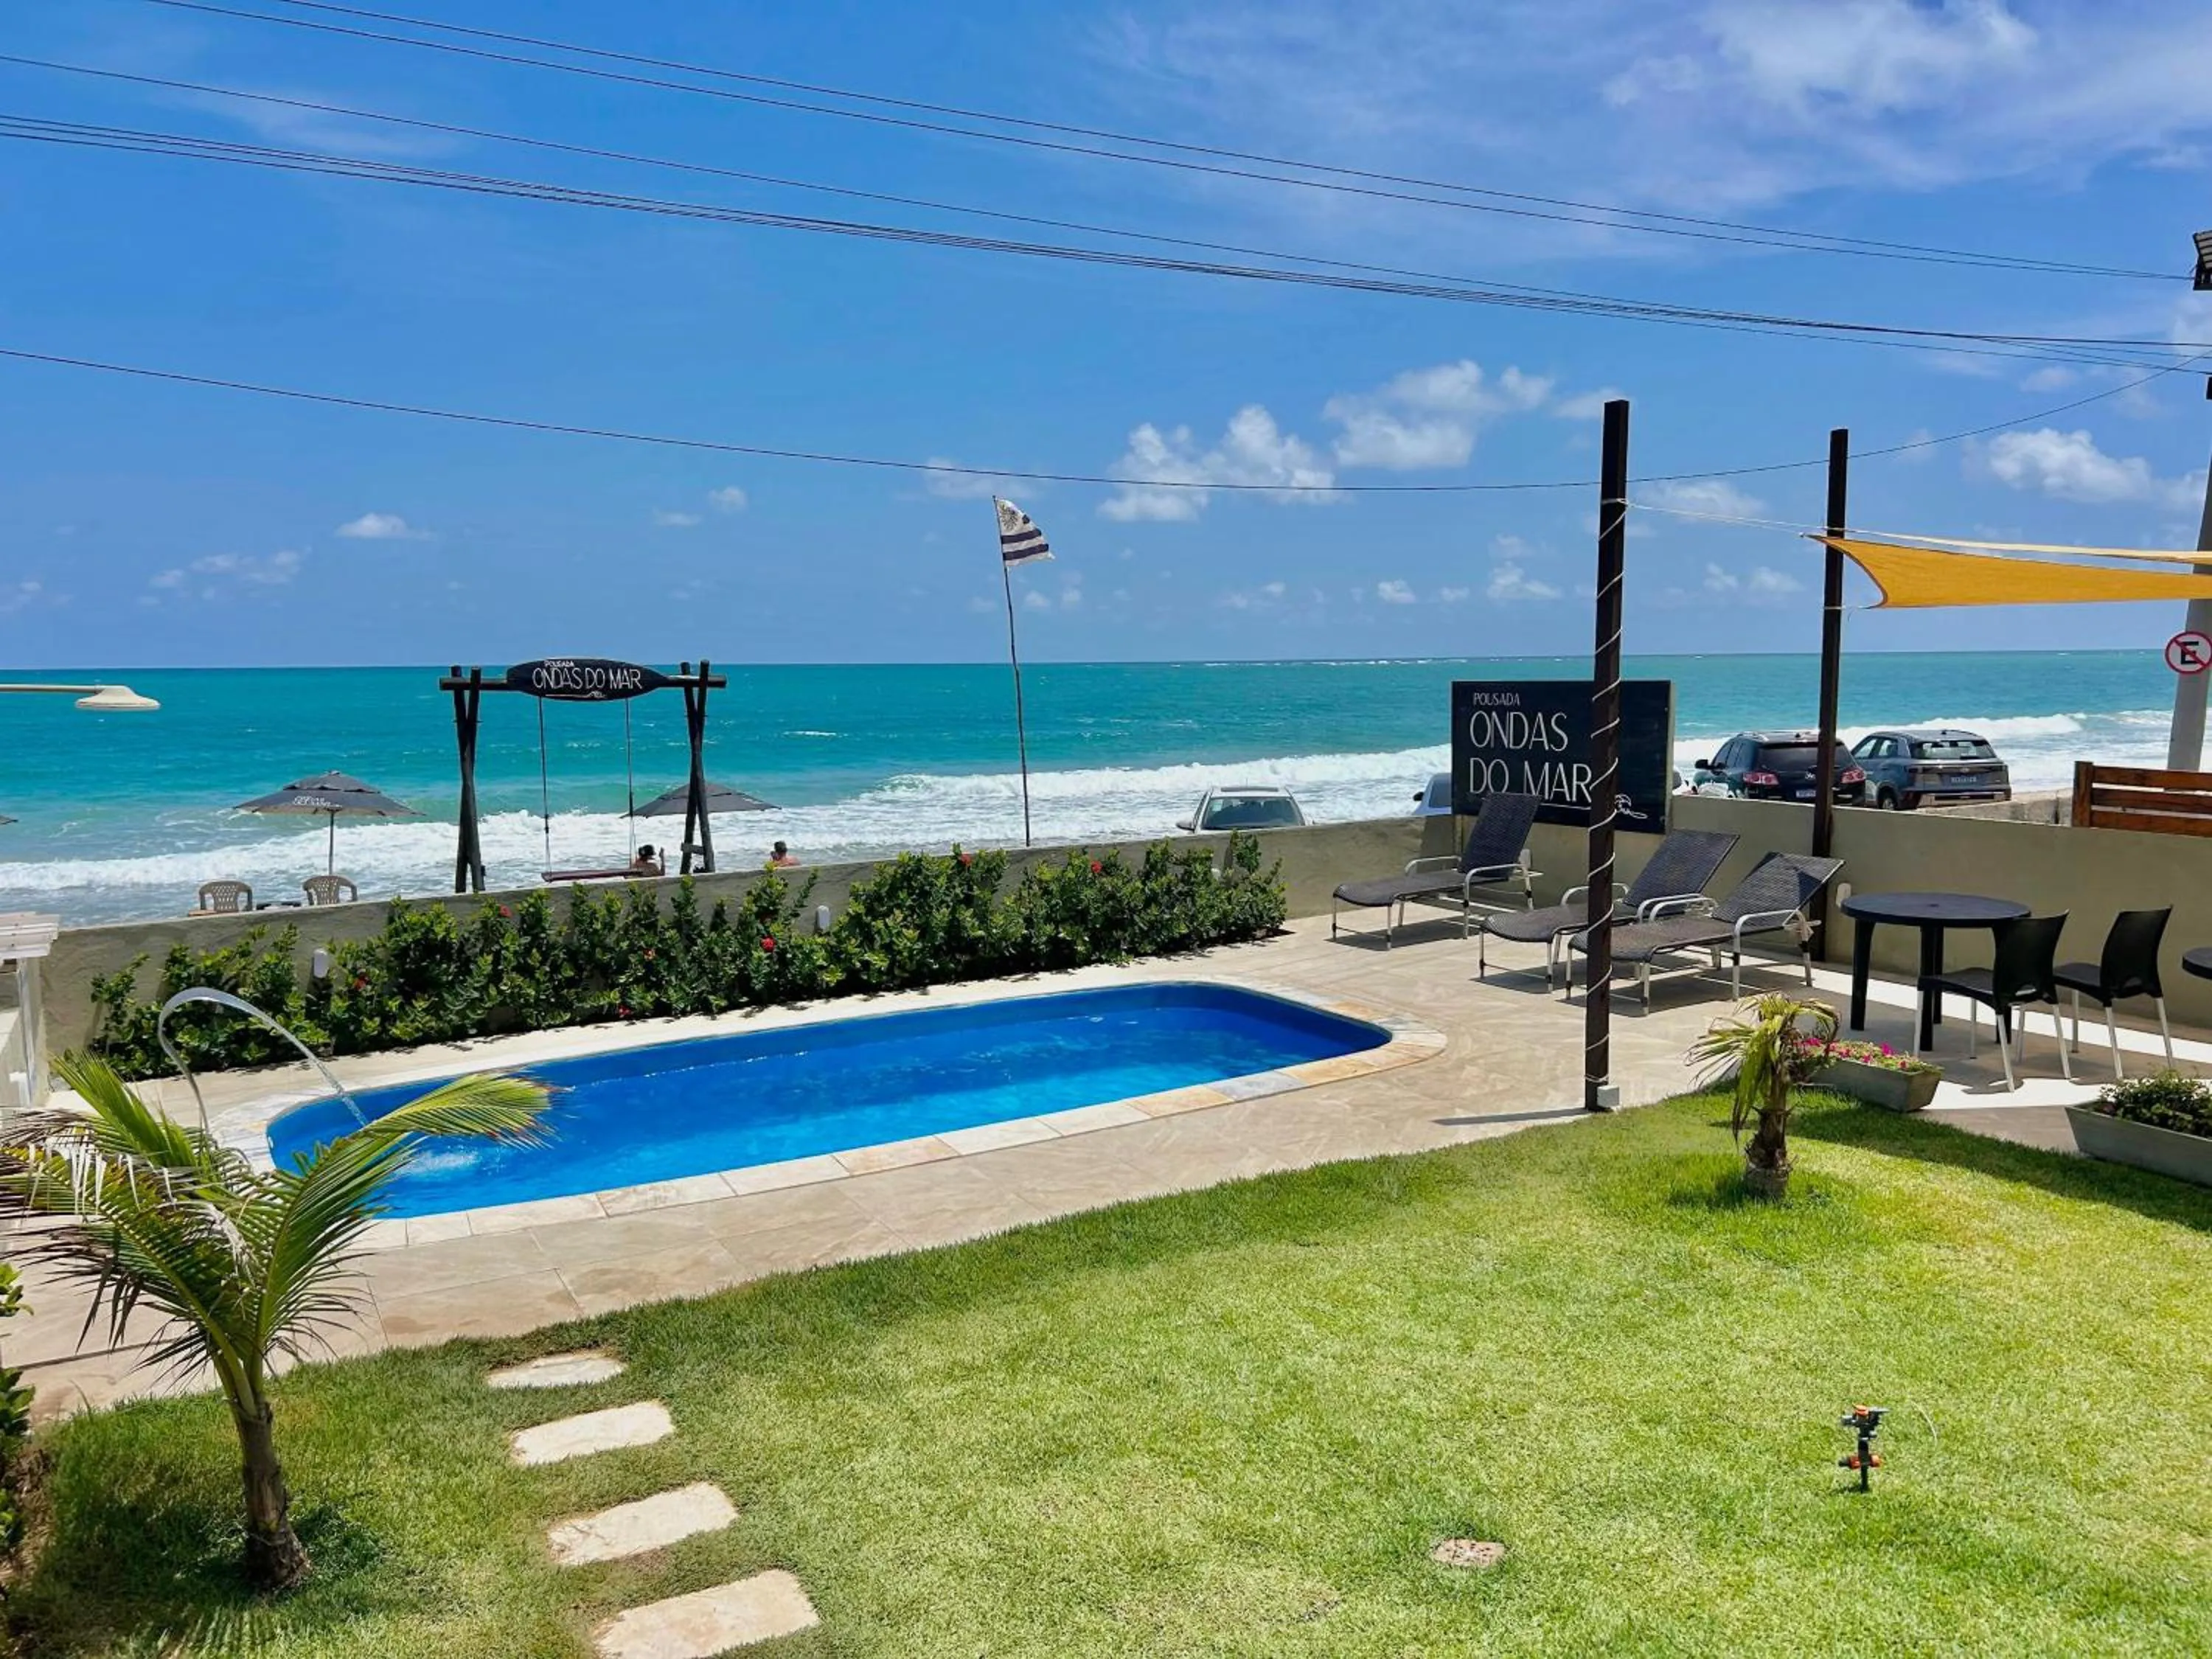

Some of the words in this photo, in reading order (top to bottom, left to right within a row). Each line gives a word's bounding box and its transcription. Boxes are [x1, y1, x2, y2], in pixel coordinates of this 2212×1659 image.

[2180, 641, 2199, 664] E
[532, 667, 582, 690] ONDAS
[585, 667, 605, 689] DO
[609, 669, 642, 690] MAR
[1474, 692, 1520, 706] POUSADA
[1470, 710, 1568, 751] ONDAS
[1470, 757, 1509, 794] DO
[1523, 760, 1592, 803] MAR
